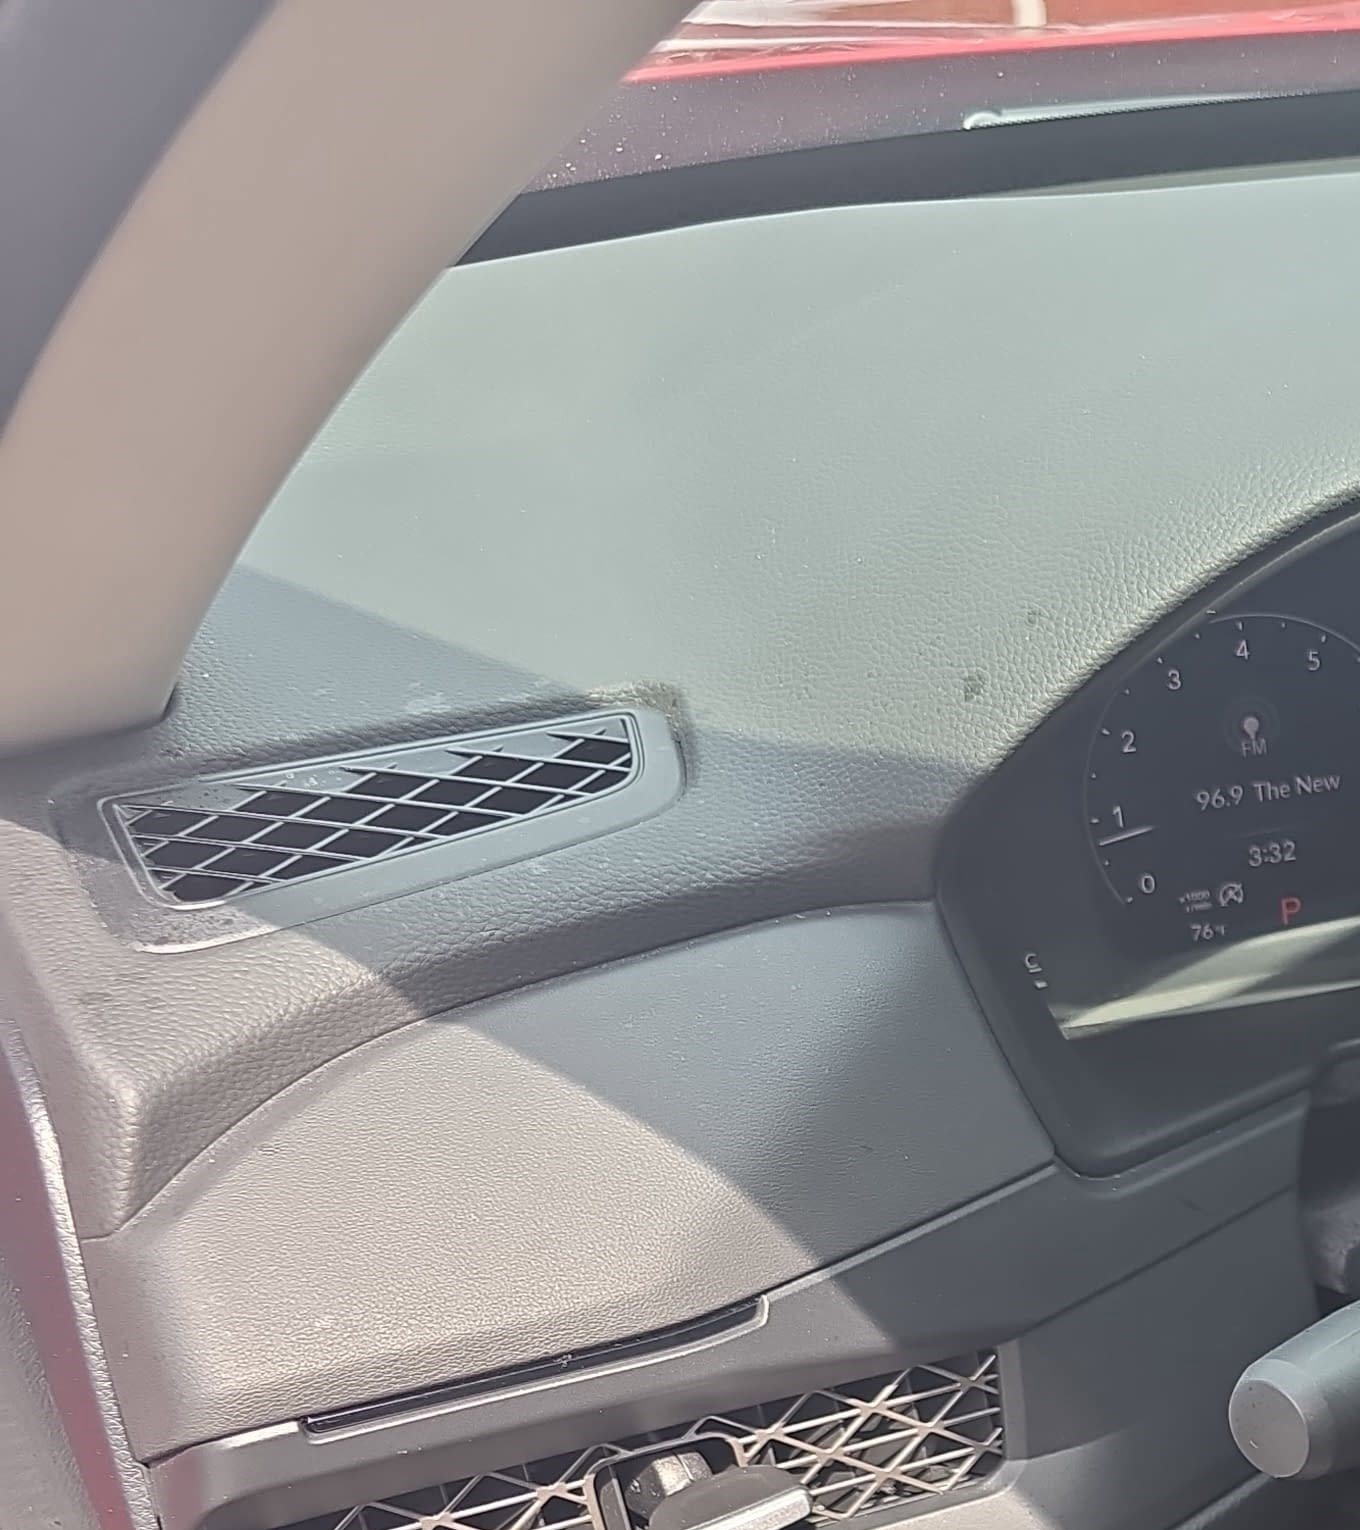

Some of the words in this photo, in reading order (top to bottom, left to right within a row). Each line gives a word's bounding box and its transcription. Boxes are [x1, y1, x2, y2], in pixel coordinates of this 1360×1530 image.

[1234, 640, 1250, 661] 4
[1308, 650, 1321, 671] 5
[1167, 670, 1182, 691] 3
[1120, 731, 1137, 753] 2
[1241, 739, 1268, 757] FM
[1195, 785, 1244, 811] 96.9
[1253, 780, 1291, 802] The
[1295, 773, 1341, 795] New
[1112, 805, 1125, 828] 1
[1248, 840, 1296, 867] 3:32
[1138, 873, 1156, 893] 0
[1281, 897, 1302, 925] P
